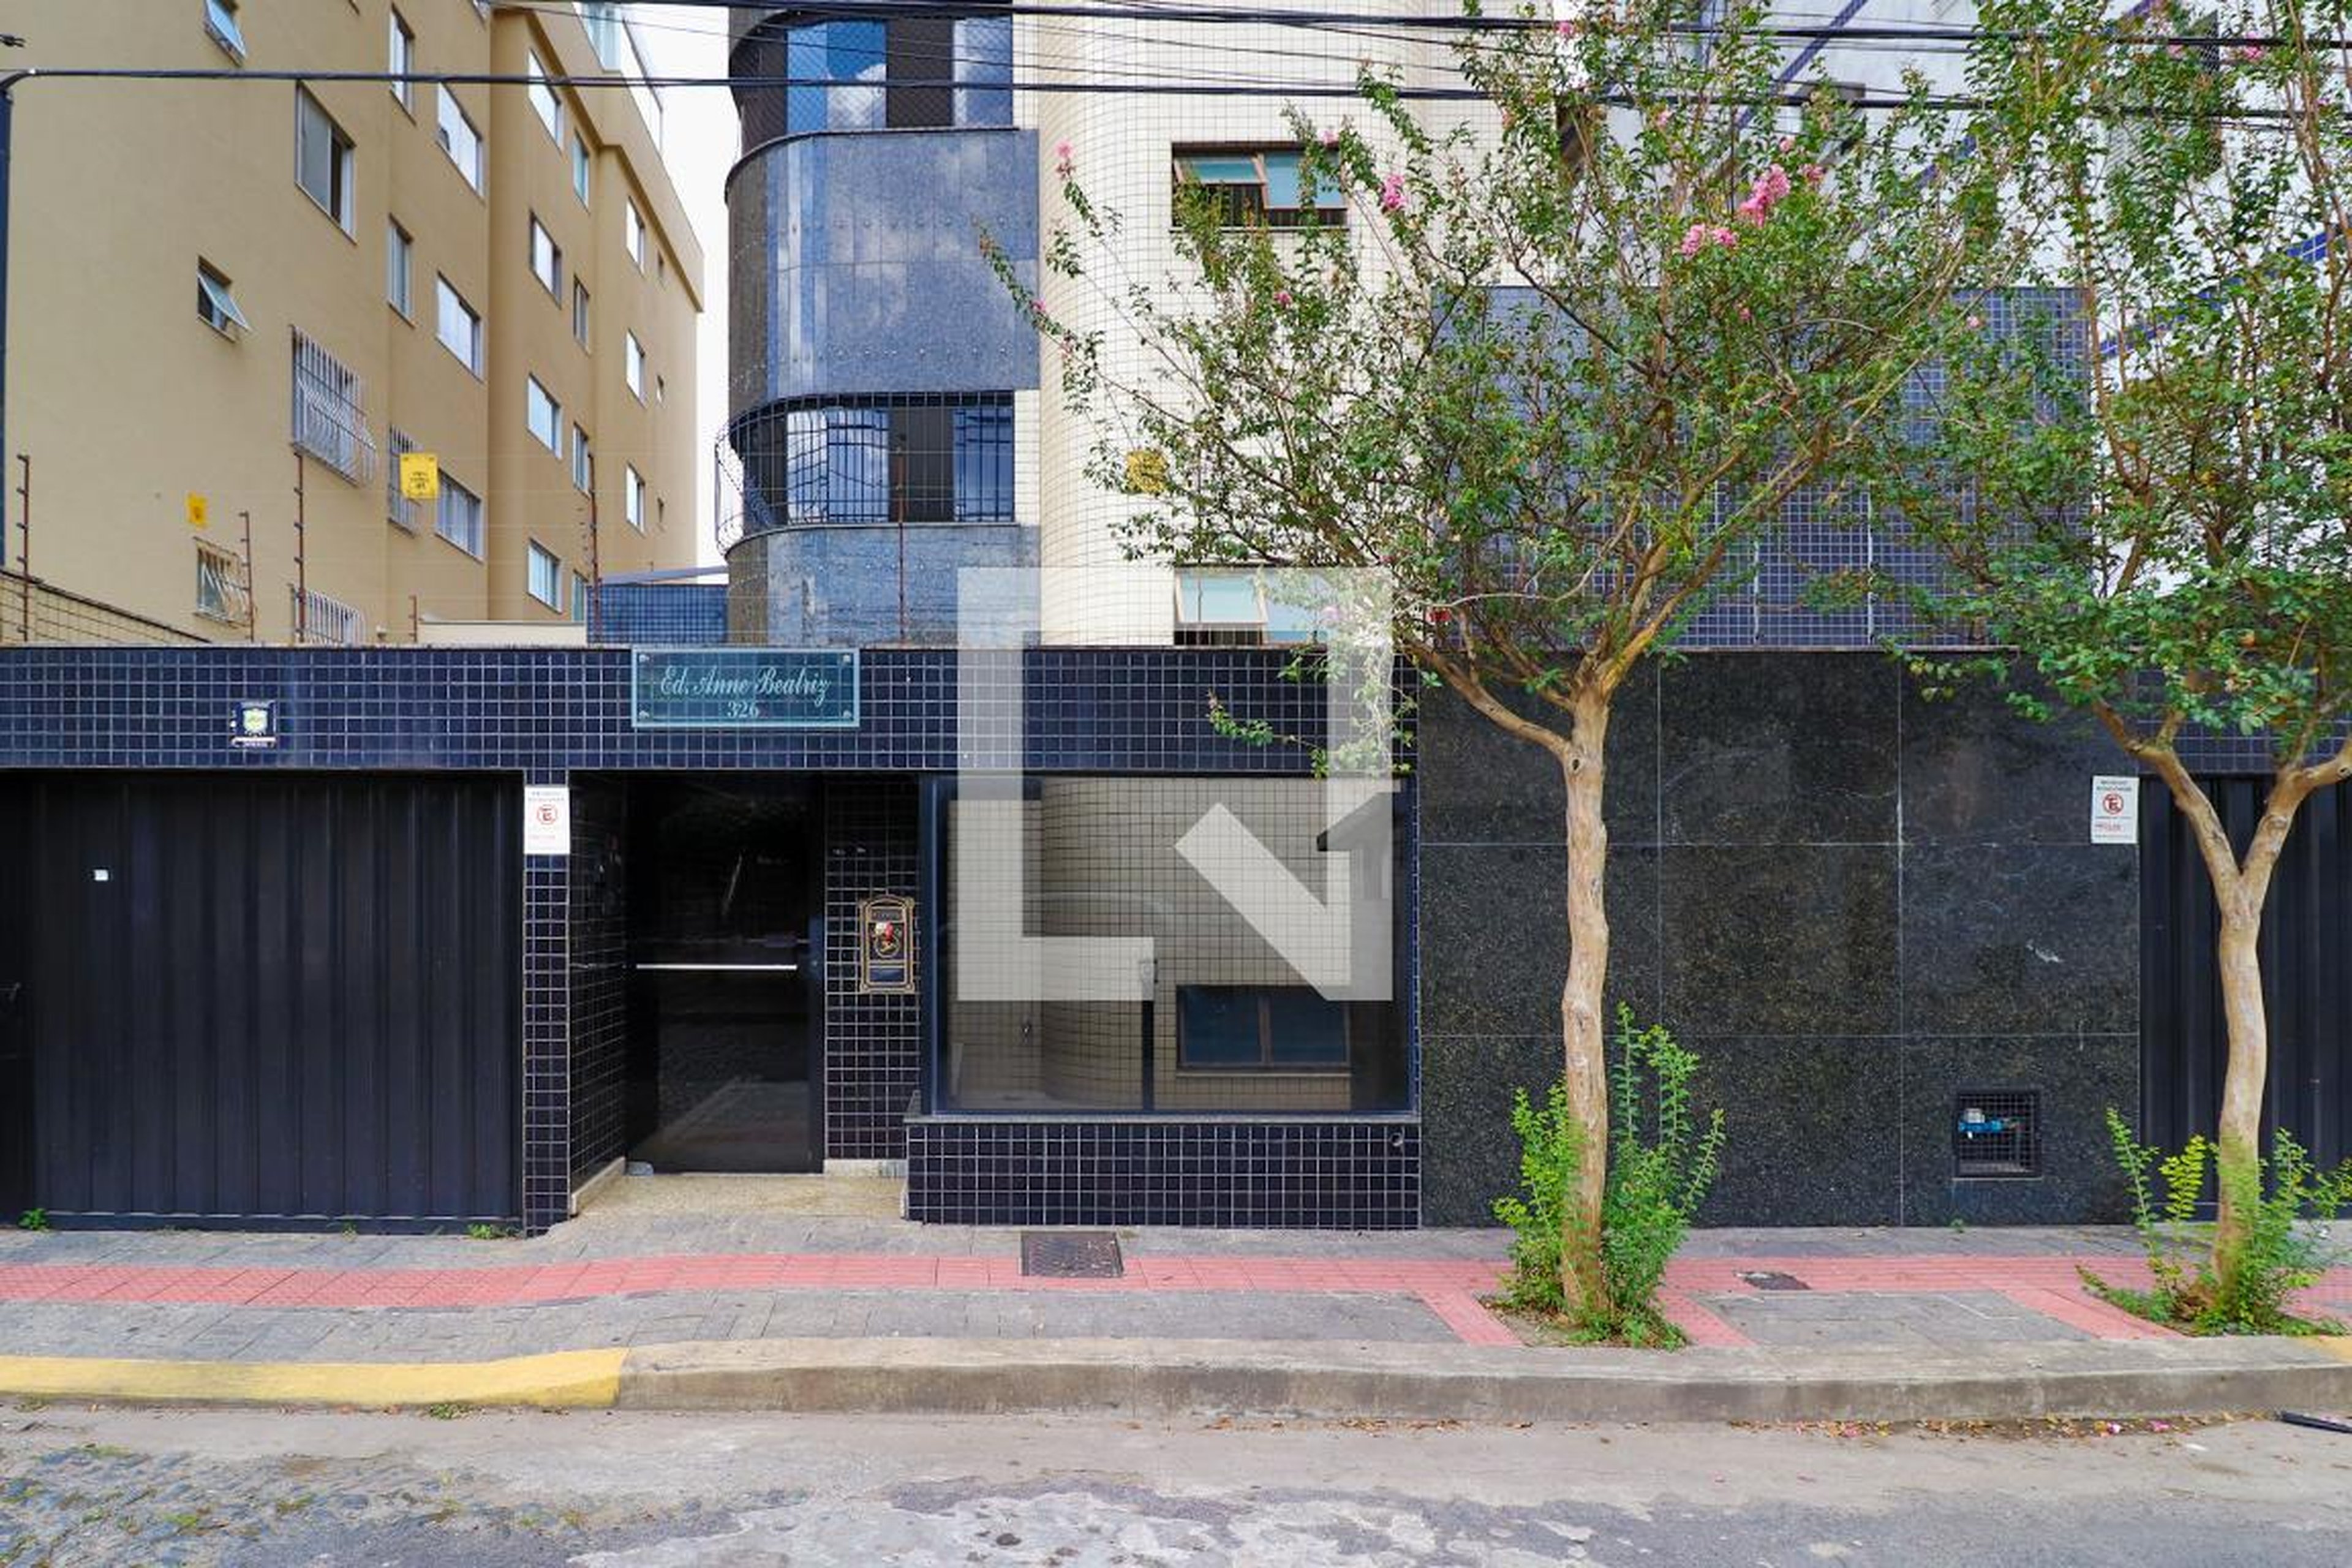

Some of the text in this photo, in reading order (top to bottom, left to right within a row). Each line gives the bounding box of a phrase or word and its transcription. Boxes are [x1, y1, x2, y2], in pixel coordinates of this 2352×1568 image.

[661, 665, 831, 707] Ed. Anne Beatriz
[727, 701, 759, 718] 326
